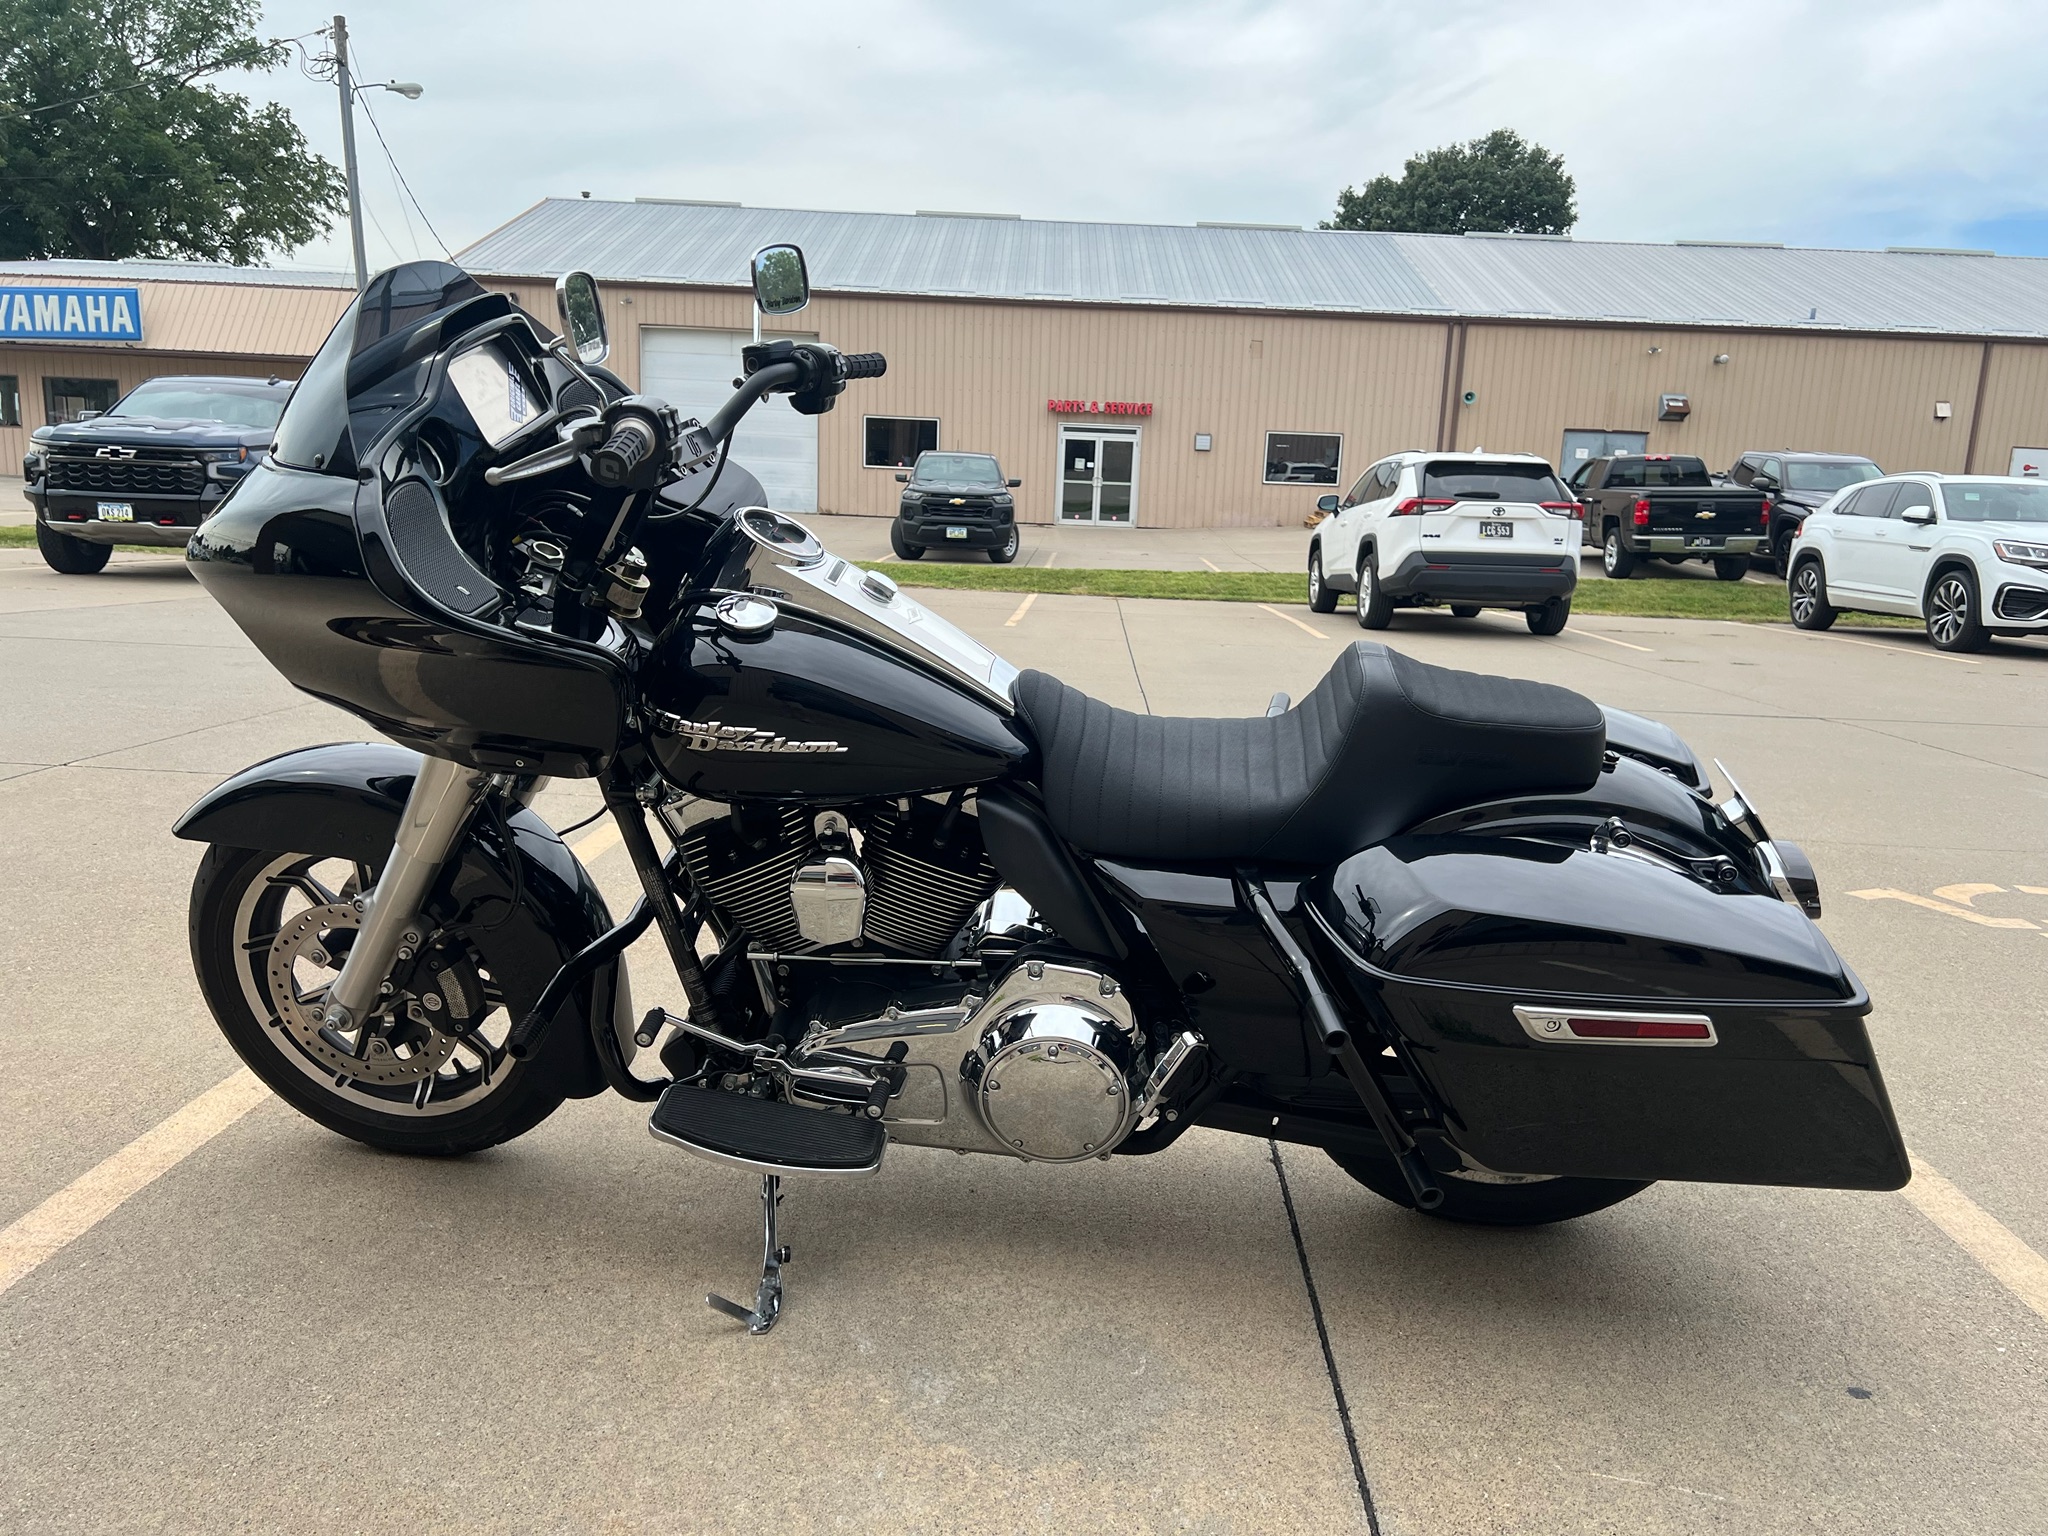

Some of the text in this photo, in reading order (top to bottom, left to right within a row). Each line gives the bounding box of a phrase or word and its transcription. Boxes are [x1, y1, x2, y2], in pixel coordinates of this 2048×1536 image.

[0, 294, 135, 334] YAMAHA
[1047, 399, 1153, 416] PARTS & SERVICE
[679, 732, 848, 752] Davidson
